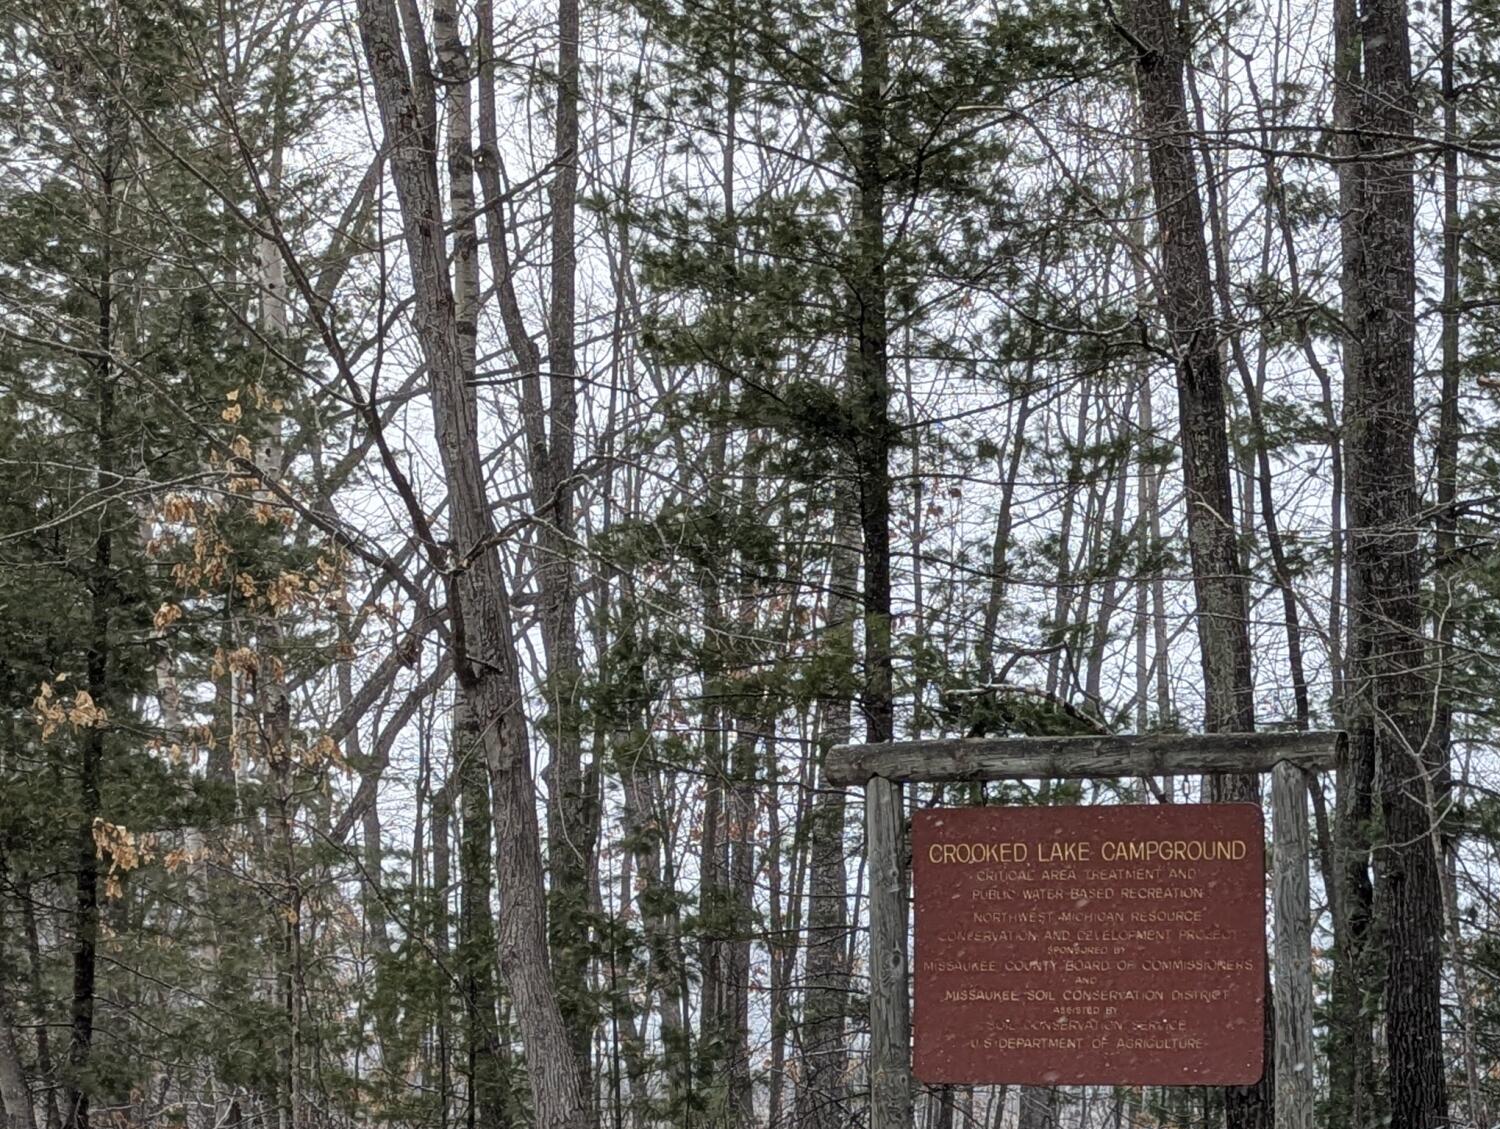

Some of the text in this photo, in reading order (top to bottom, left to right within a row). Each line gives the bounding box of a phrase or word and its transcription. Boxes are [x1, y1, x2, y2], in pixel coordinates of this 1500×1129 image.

[929, 840, 1247, 864] CROOKED LAKE CAMPGROUND
[976, 868, 1197, 881] CRITICAL AREA TREATMENT AND
[972, 888, 1016, 900] PUBLIC
[1120, 887, 1203, 899] RECREATION
[973, 910, 1202, 923] NORTHWEST MICHIGAN RESOURCE
[1044, 930, 1071, 942] AND
[1077, 929, 1171, 941] DEVELOPMENT
[923, 960, 1254, 972] MISSAUKEE COUNTY BOARD OF COMMISSIONERS
[1075, 976, 1097, 985] AND
[945, 989, 1230, 1001] MISSAUKEE SOIL CONSERVATION DISTRICT
[1105, 1006, 1117, 1015] BY
[999, 1038, 1083, 1049] DEPARTMENT
[1092, 1038, 1109, 1049] OF
[1116, 1038, 1204, 1049] AGRICULTURE
